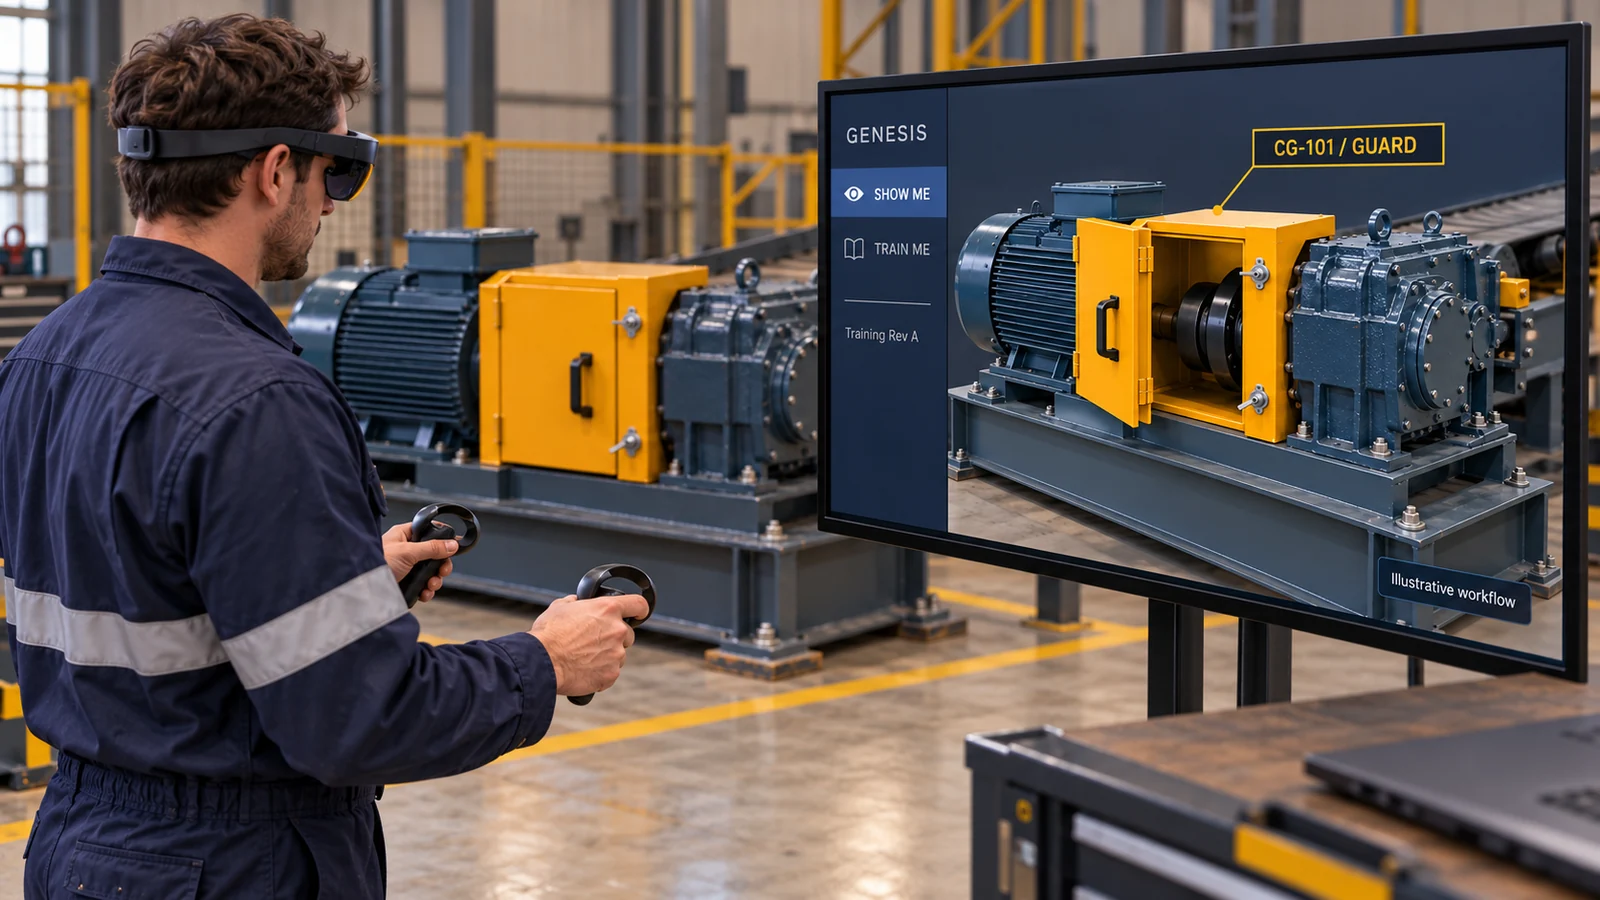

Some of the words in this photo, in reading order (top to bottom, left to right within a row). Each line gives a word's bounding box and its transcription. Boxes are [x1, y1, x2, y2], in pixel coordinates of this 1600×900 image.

[846, 124, 927, 144] GENESIS
[1274, 138, 1334, 157] CG-101
[1339, 137, 1348, 157] /
[1352, 136, 1417, 155] GUARD
[874, 187, 910, 201] SHOW
[912, 187, 931, 201] ME
[874, 242, 909, 256] TRAIN
[912, 242, 930, 256] ME
[845, 326, 886, 344] Training
[888, 329, 909, 342] Rev
[910, 330, 919, 343] A
[1391, 572, 1455, 597] Illustrative
[1457, 588, 1517, 609] workflow
